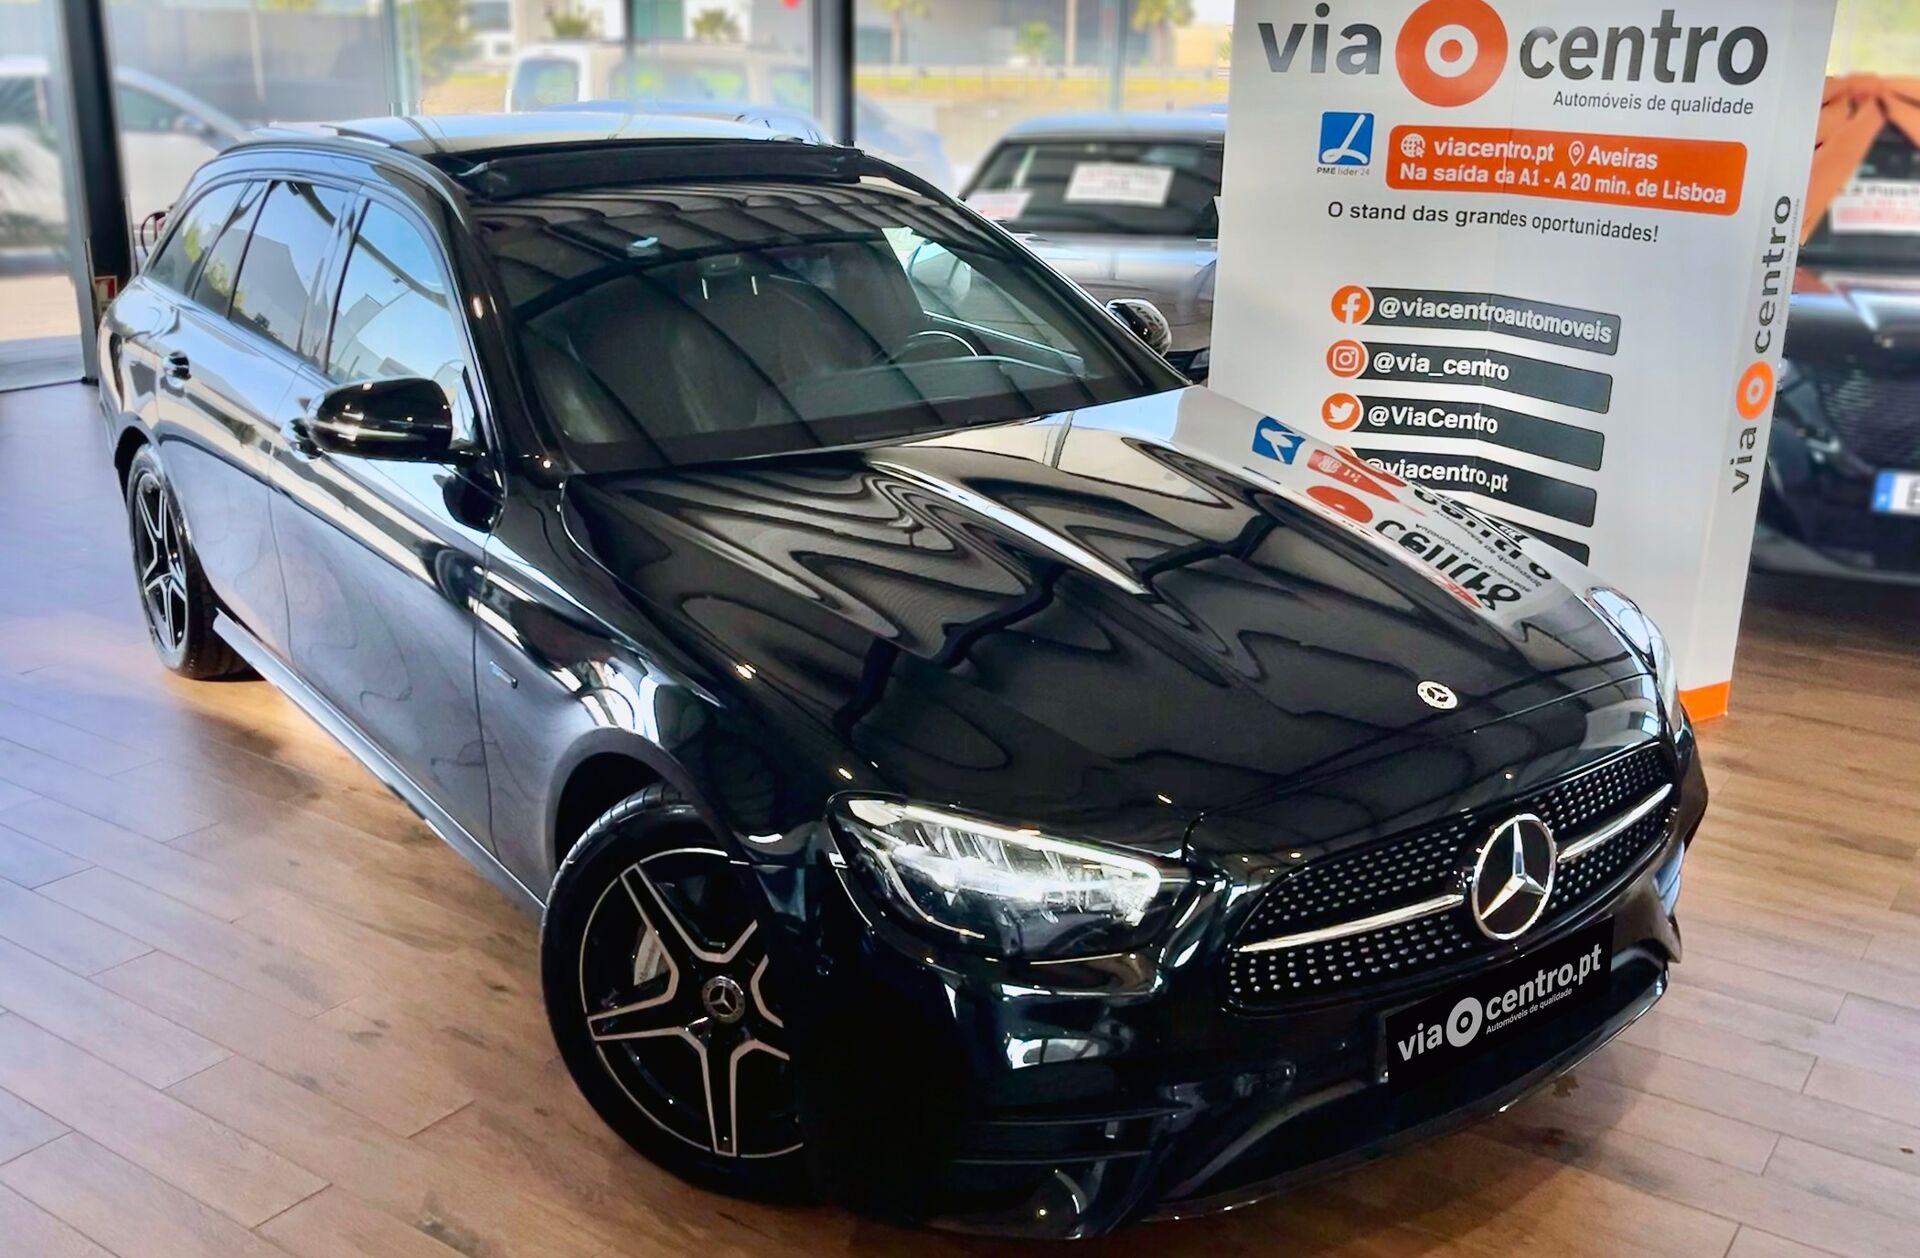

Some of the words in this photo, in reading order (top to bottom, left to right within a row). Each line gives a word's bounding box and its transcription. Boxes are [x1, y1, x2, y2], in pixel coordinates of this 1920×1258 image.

[1257, 2, 1383, 76] via
[1519, 9, 1769, 86] centro
[1553, 91, 1642, 110] Automóveis
[1646, 94, 1666, 111] de
[1670, 96, 1754, 116] qualidade
[1316, 167, 1336, 175] PME
[1434, 138, 1554, 165] viacentro.pt
[1587, 145, 1659, 170] Aveiras
[1399, 163, 1427, 181] Na
[1433, 164, 1488, 184] saída
[1495, 166, 1514, 185] da
[1519, 168, 1539, 187] A1
[1553, 172, 1567, 189] A
[1570, 172, 1591, 192] 20
[1595, 174, 1631, 196] min.
[1635, 178, 1658, 199] de
[1662, 180, 1727, 205] Lisboa
[1328, 201, 1343, 218] O
[1349, 204, 1406, 220] stand
[1412, 205, 1449, 222] das
[1455, 209, 1527, 228] grandes
[1532, 213, 1659, 243] oportunidades!
[1378, 297, 1613, 344] @viacentroautomoveis
[1728, 427, 1757, 494] via
[1755, 195, 1791, 354] centro
[1373, 352, 1510, 381] @via_centro
[1368, 405, 1499, 434] @ViaCentro
[1397, 1022, 1443, 1062] via
[1486, 943, 1602, 1021] centro.pt
[1486, 1008, 1529, 1035] Automóveis
[1529, 1003, 1539, 1014] de
[1539, 988, 1573, 1010] qualidade
